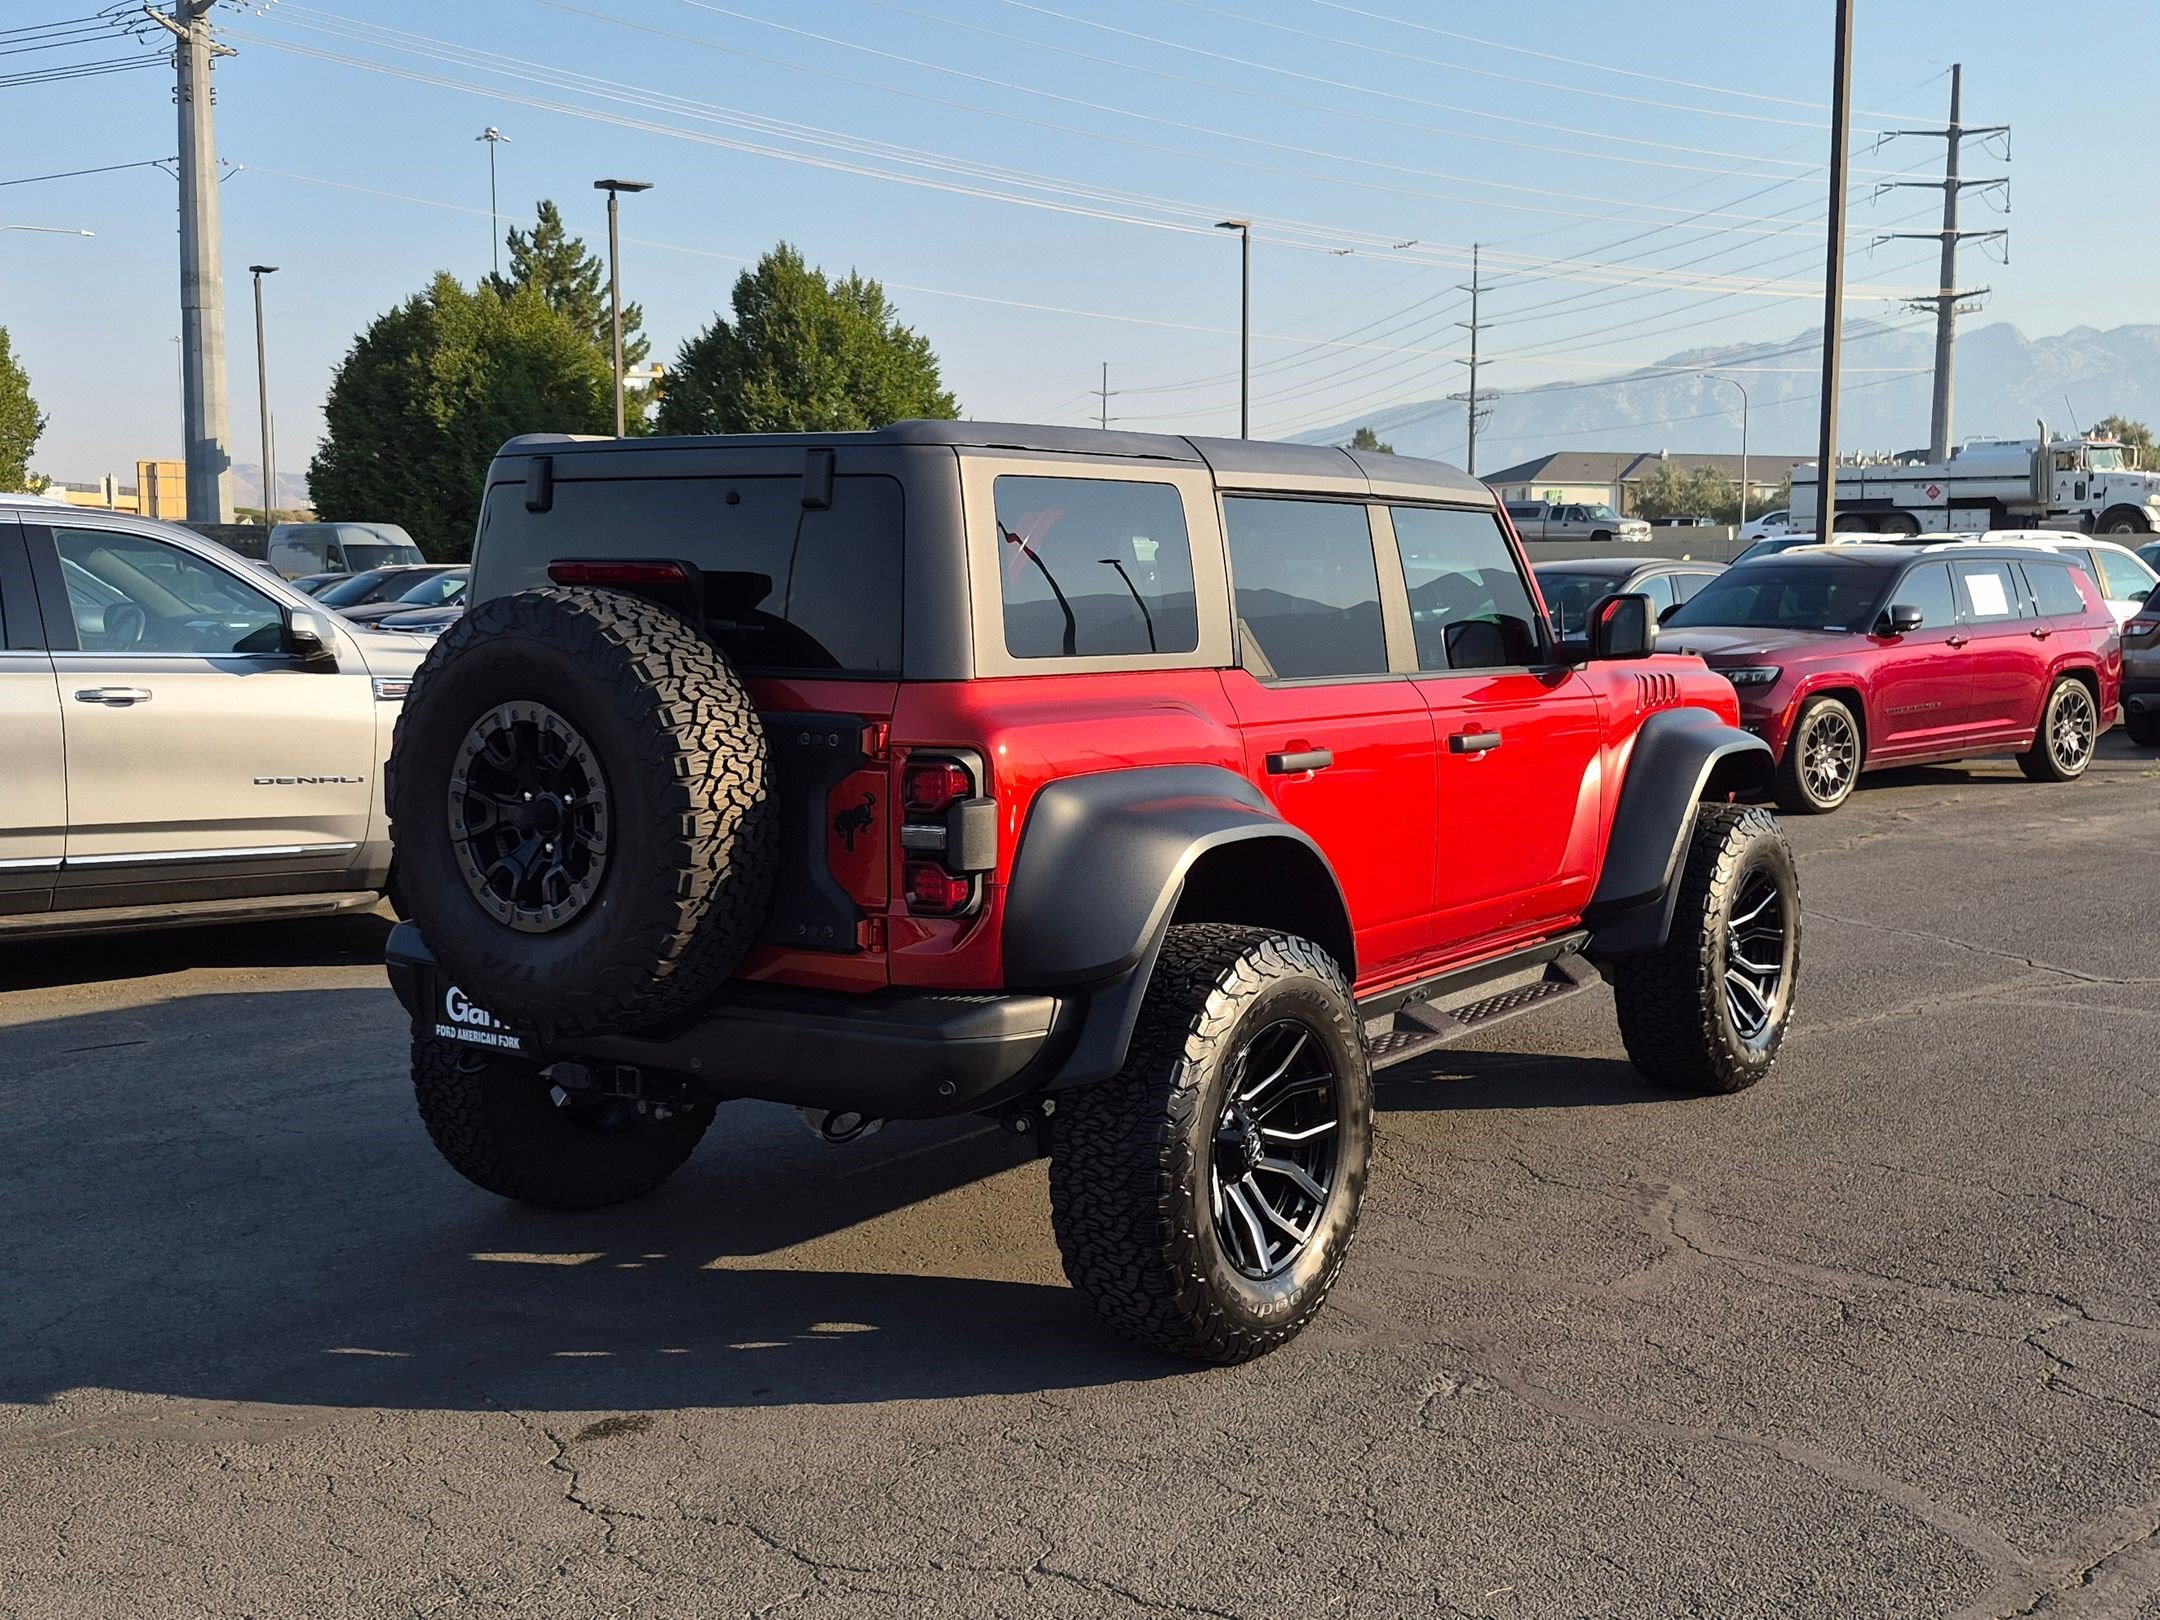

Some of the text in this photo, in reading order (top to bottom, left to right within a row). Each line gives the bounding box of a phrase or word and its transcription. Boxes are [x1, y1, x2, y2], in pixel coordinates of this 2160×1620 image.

[253, 776, 364, 785] DENALI
[435, 1023, 456, 1039] FORD
[457, 1028, 497, 1046] AMERICAN
